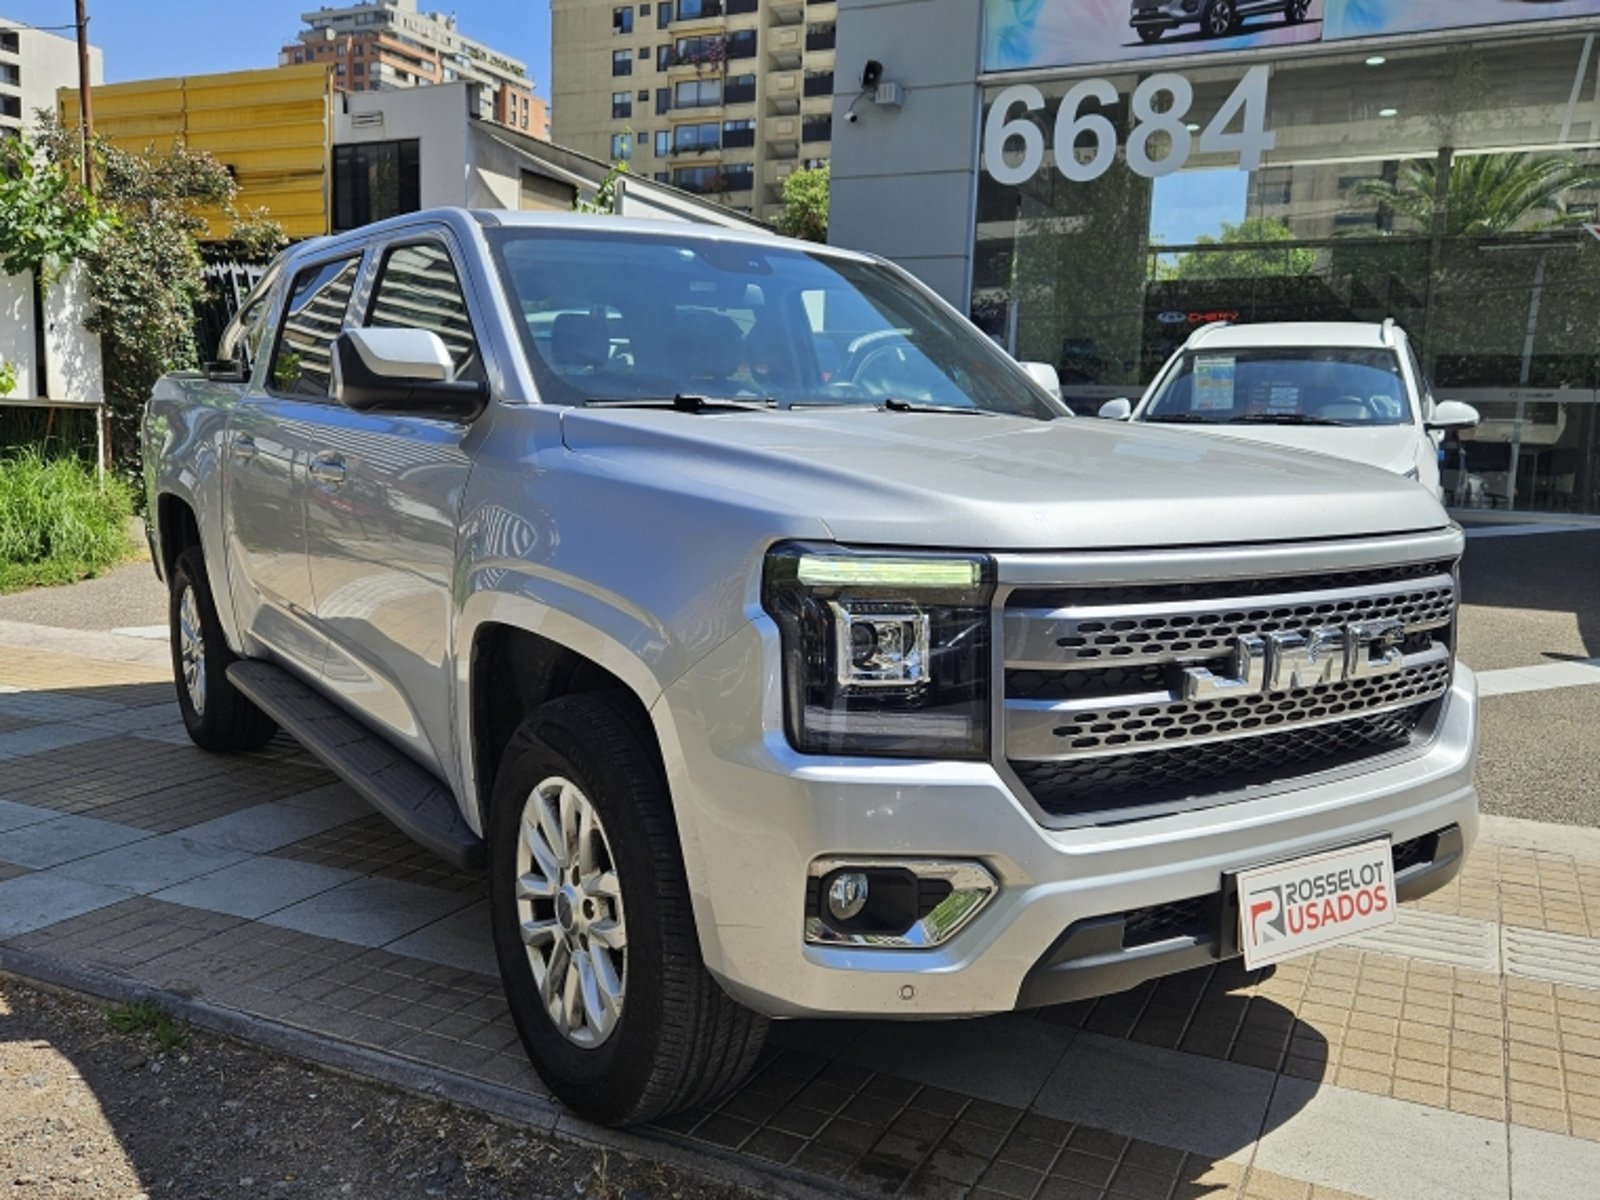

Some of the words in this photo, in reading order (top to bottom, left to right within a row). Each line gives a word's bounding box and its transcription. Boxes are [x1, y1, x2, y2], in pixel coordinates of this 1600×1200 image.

[984, 65, 1276, 185] 6684
[1187, 311, 1240, 322] CHERY
[1184, 618, 1405, 700] JMC
[1285, 861, 1384, 906] ROSSELOT
[1287, 886, 1388, 934] USADOS
